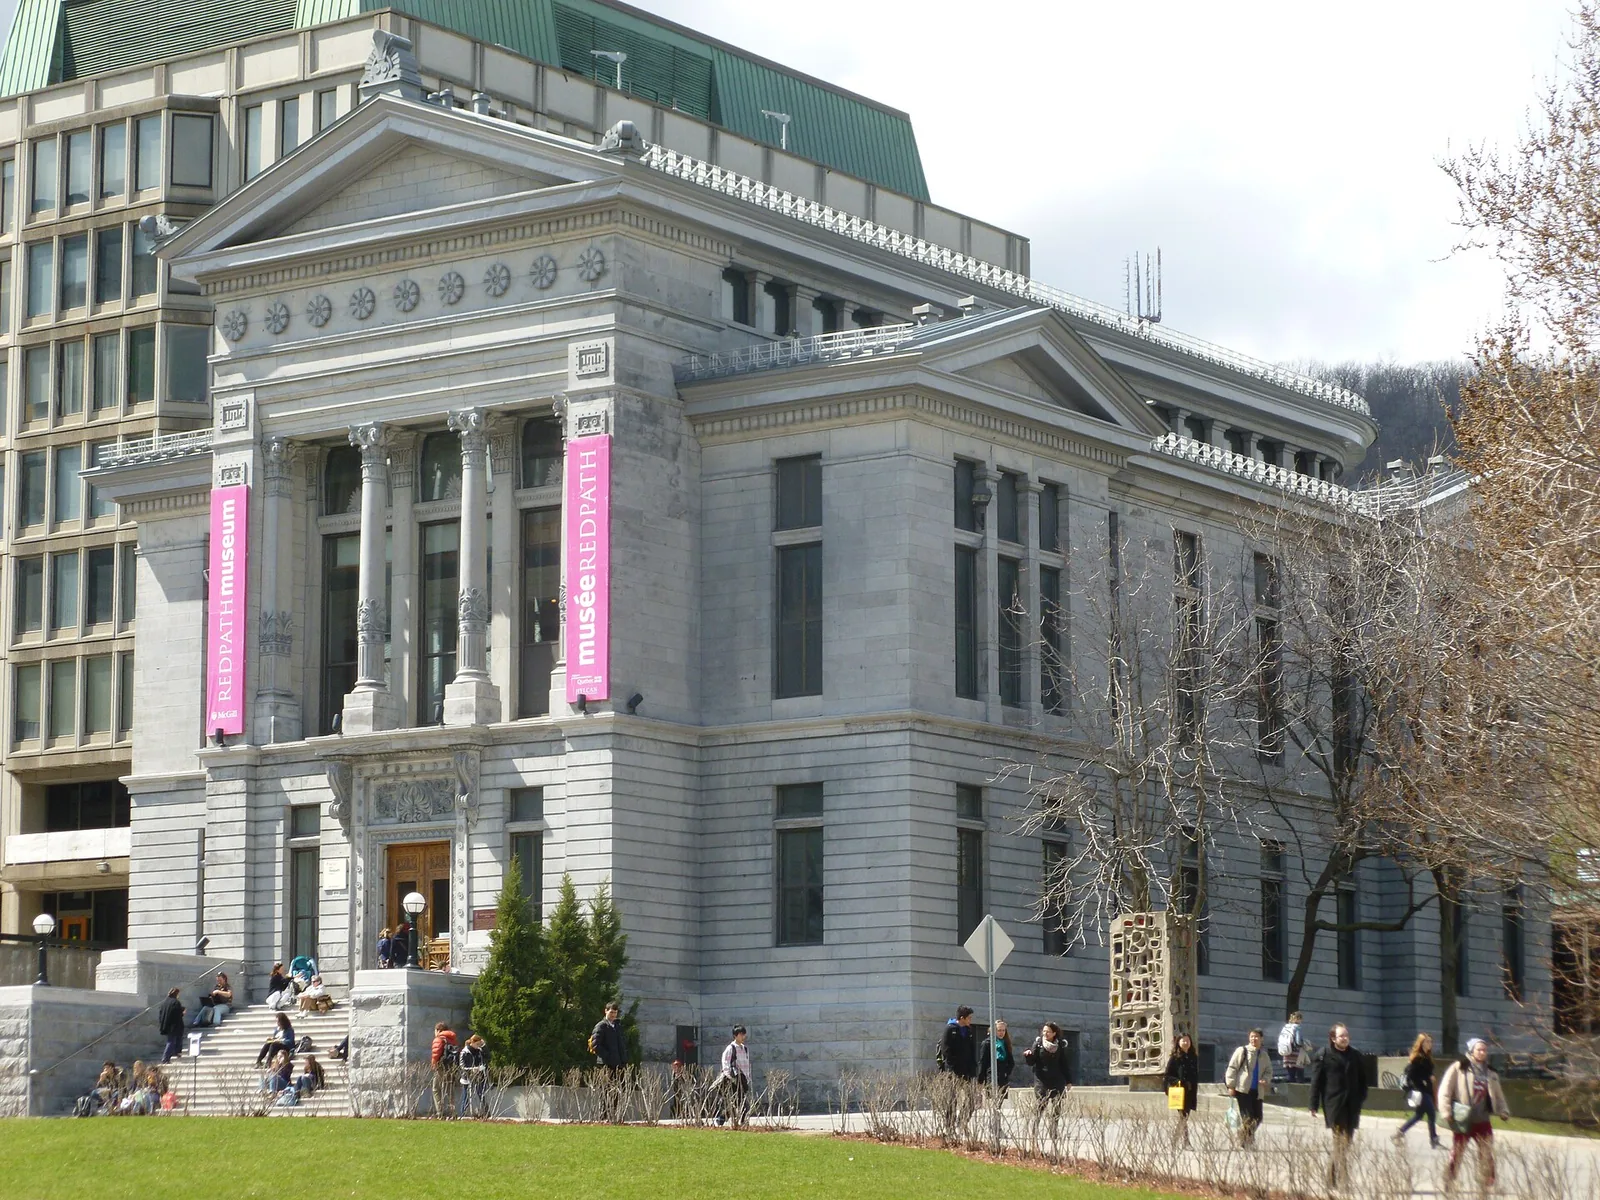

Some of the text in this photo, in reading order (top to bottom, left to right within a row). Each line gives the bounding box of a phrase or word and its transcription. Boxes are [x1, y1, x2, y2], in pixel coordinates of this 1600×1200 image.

[579, 450, 597, 570] REDPATH
[218, 499, 236, 701] REDPATH museum
[574, 574, 596, 665] musée
[217, 709, 238, 719] McGill
